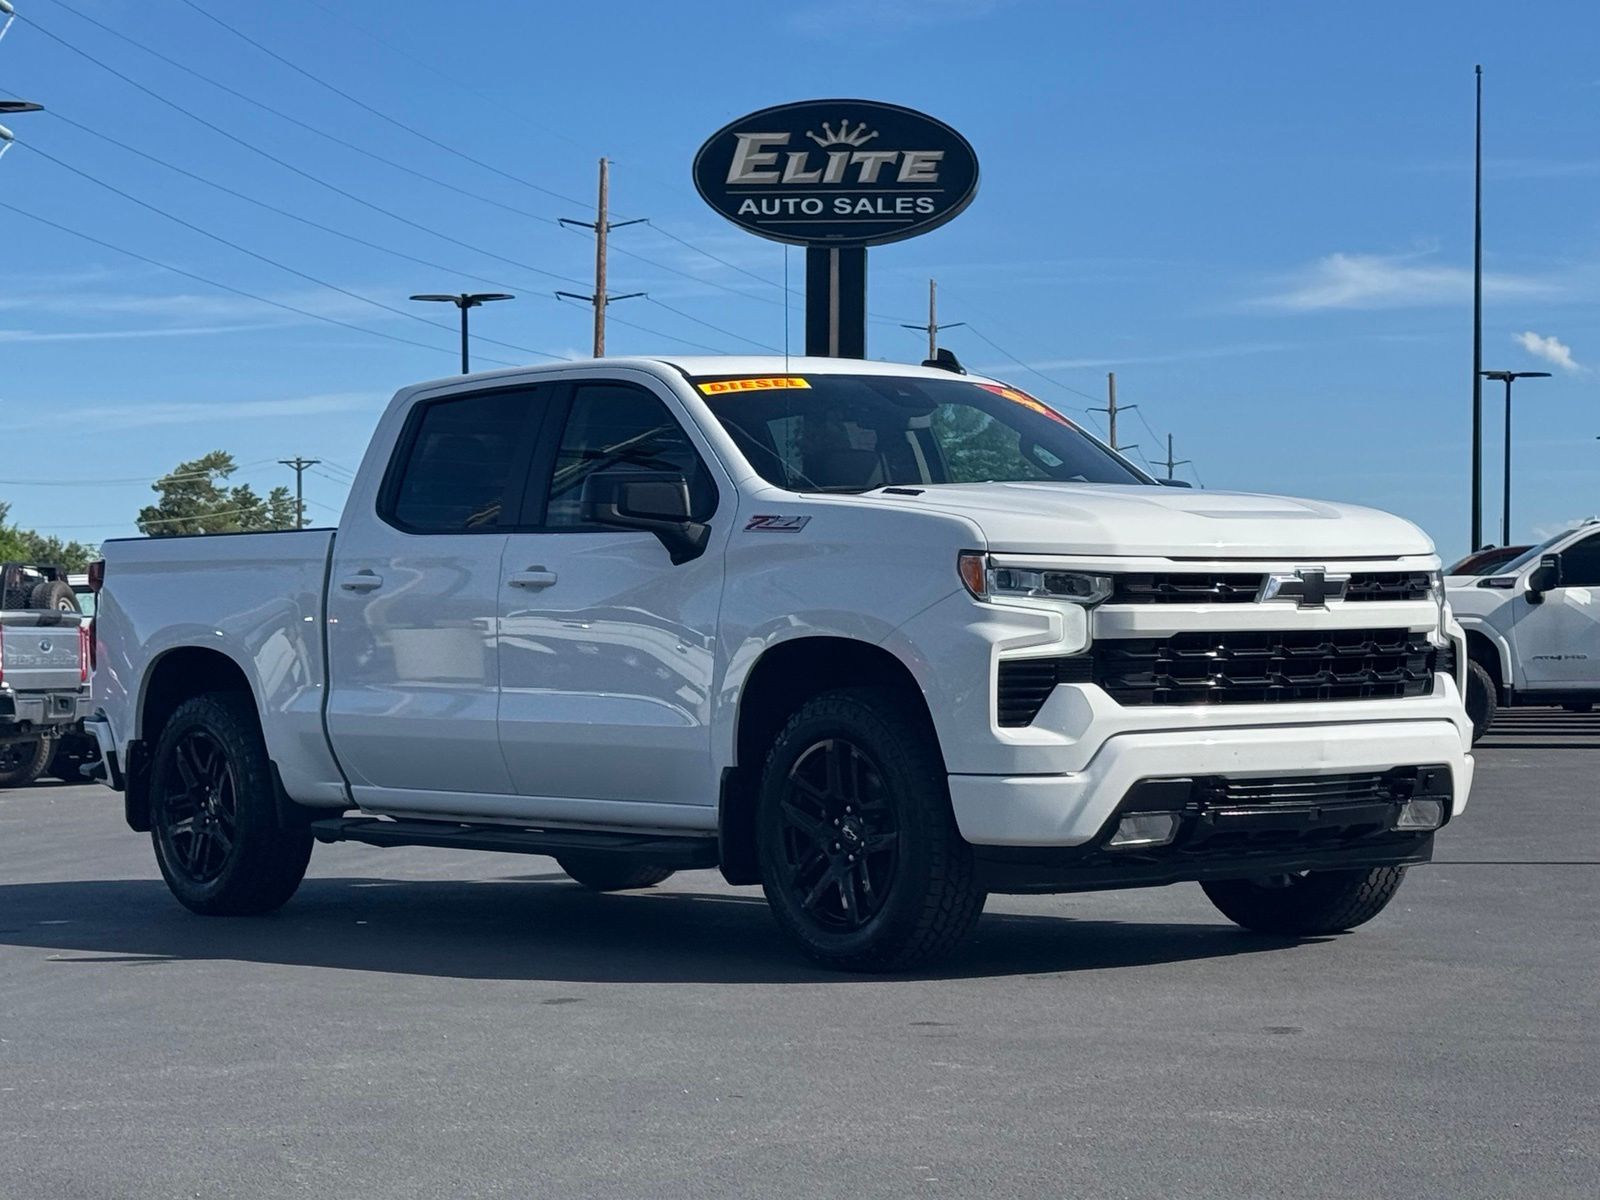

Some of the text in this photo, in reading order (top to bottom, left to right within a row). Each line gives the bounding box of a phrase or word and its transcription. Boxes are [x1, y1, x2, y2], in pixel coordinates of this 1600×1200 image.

[725, 132, 945, 185] ELITE
[737, 197, 935, 216] AUTO SALES
[710, 379, 800, 392] DIESEL
